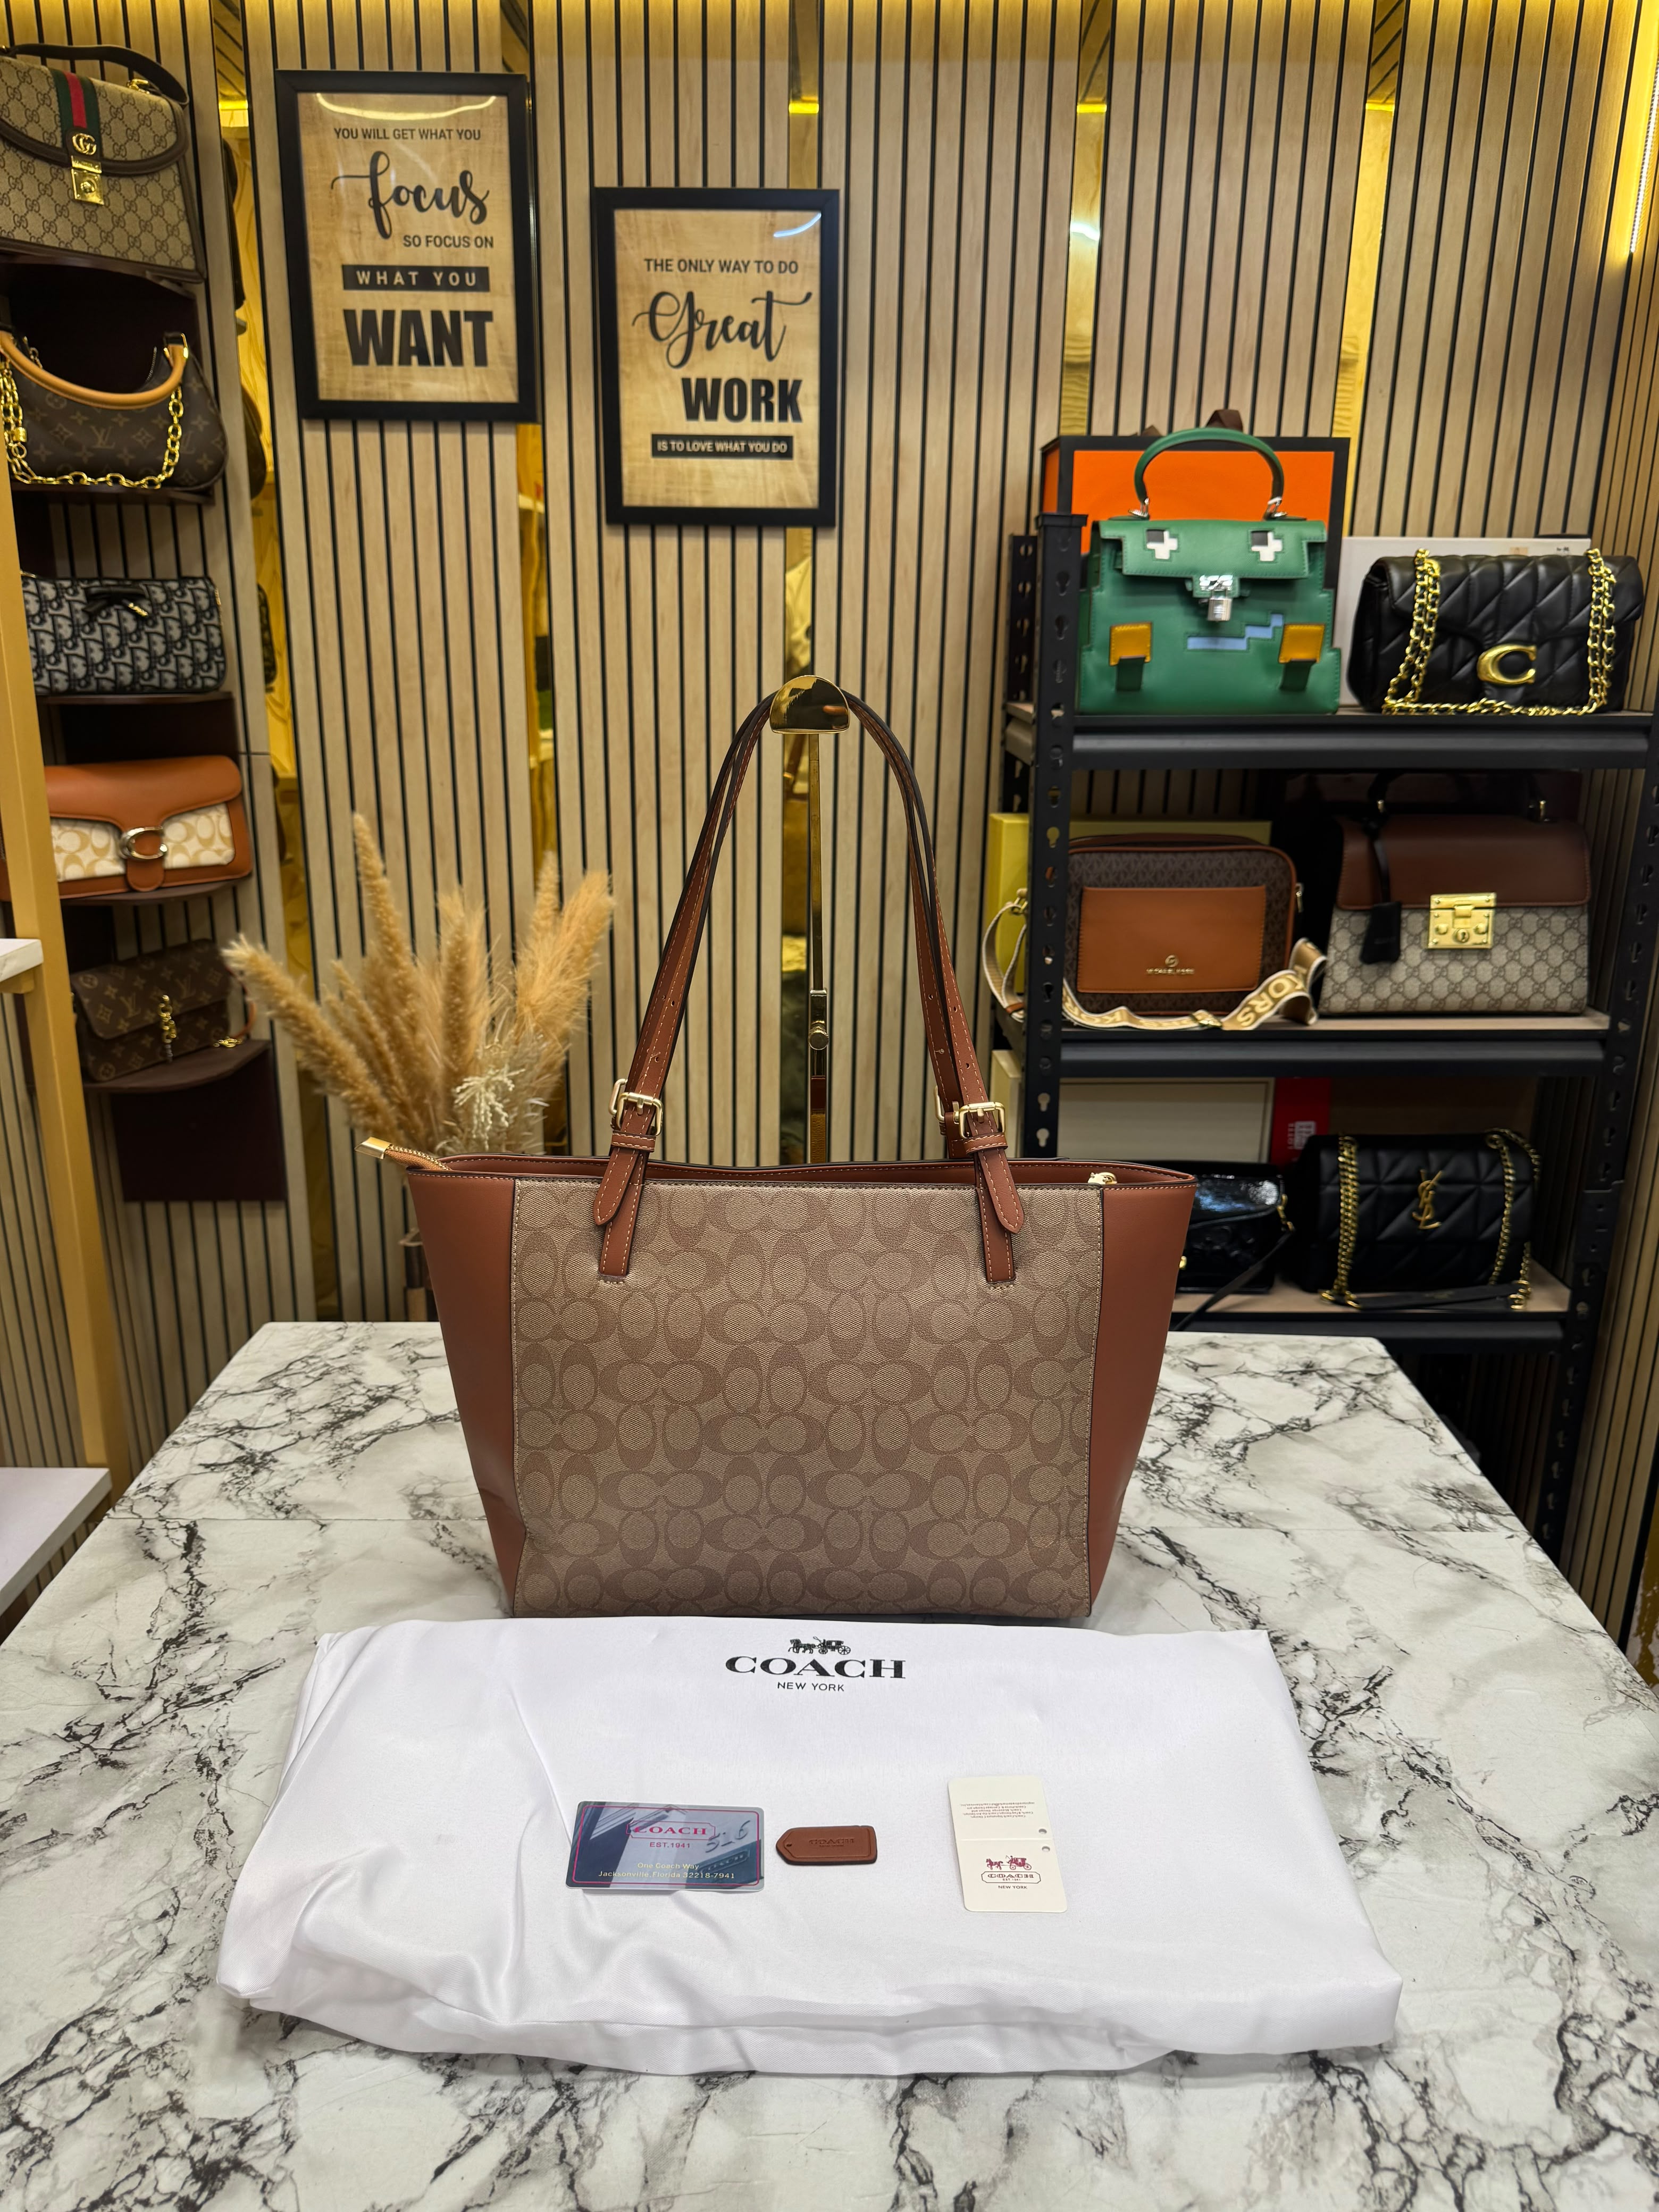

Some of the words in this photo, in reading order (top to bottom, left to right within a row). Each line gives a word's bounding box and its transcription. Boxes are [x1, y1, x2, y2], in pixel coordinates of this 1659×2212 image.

[334, 128, 358, 139] YOU
[362, 128, 390, 140] WILL
[393, 129, 416, 140] GET
[418, 129, 453, 140] WHAT
[456, 129, 481, 141] YOU
[330, 150, 490, 239] focus
[403, 234, 421, 248] SO
[425, 236, 471, 248] FOCUS
[474, 237, 494, 249] ON
[644, 258, 674, 272] THE
[677, 259, 715, 273] ONLY
[718, 259, 751, 273] WAY
[754, 260, 774, 274] TO
[778, 261, 799, 274] DO
[356, 270, 419, 286] WHAT
[433, 272, 478, 287] YOU
[343, 308, 494, 367] WANT
[632, 290, 813, 369] Great
[681, 378, 803, 423] WORK
[657, 440, 668, 452] IS
[669, 440, 685, 452] TO
[686, 440, 714, 453] LOVE
[715, 441, 747, 453] WHAT
[748, 441, 770, 453] YOU
[772, 441, 788, 454] DO
[725, 1655, 907, 1679] COACH
[777, 1681, 807, 1690] NEW
[811, 1682, 845, 1692] YORK
[634, 1825, 707, 1835] COACH
